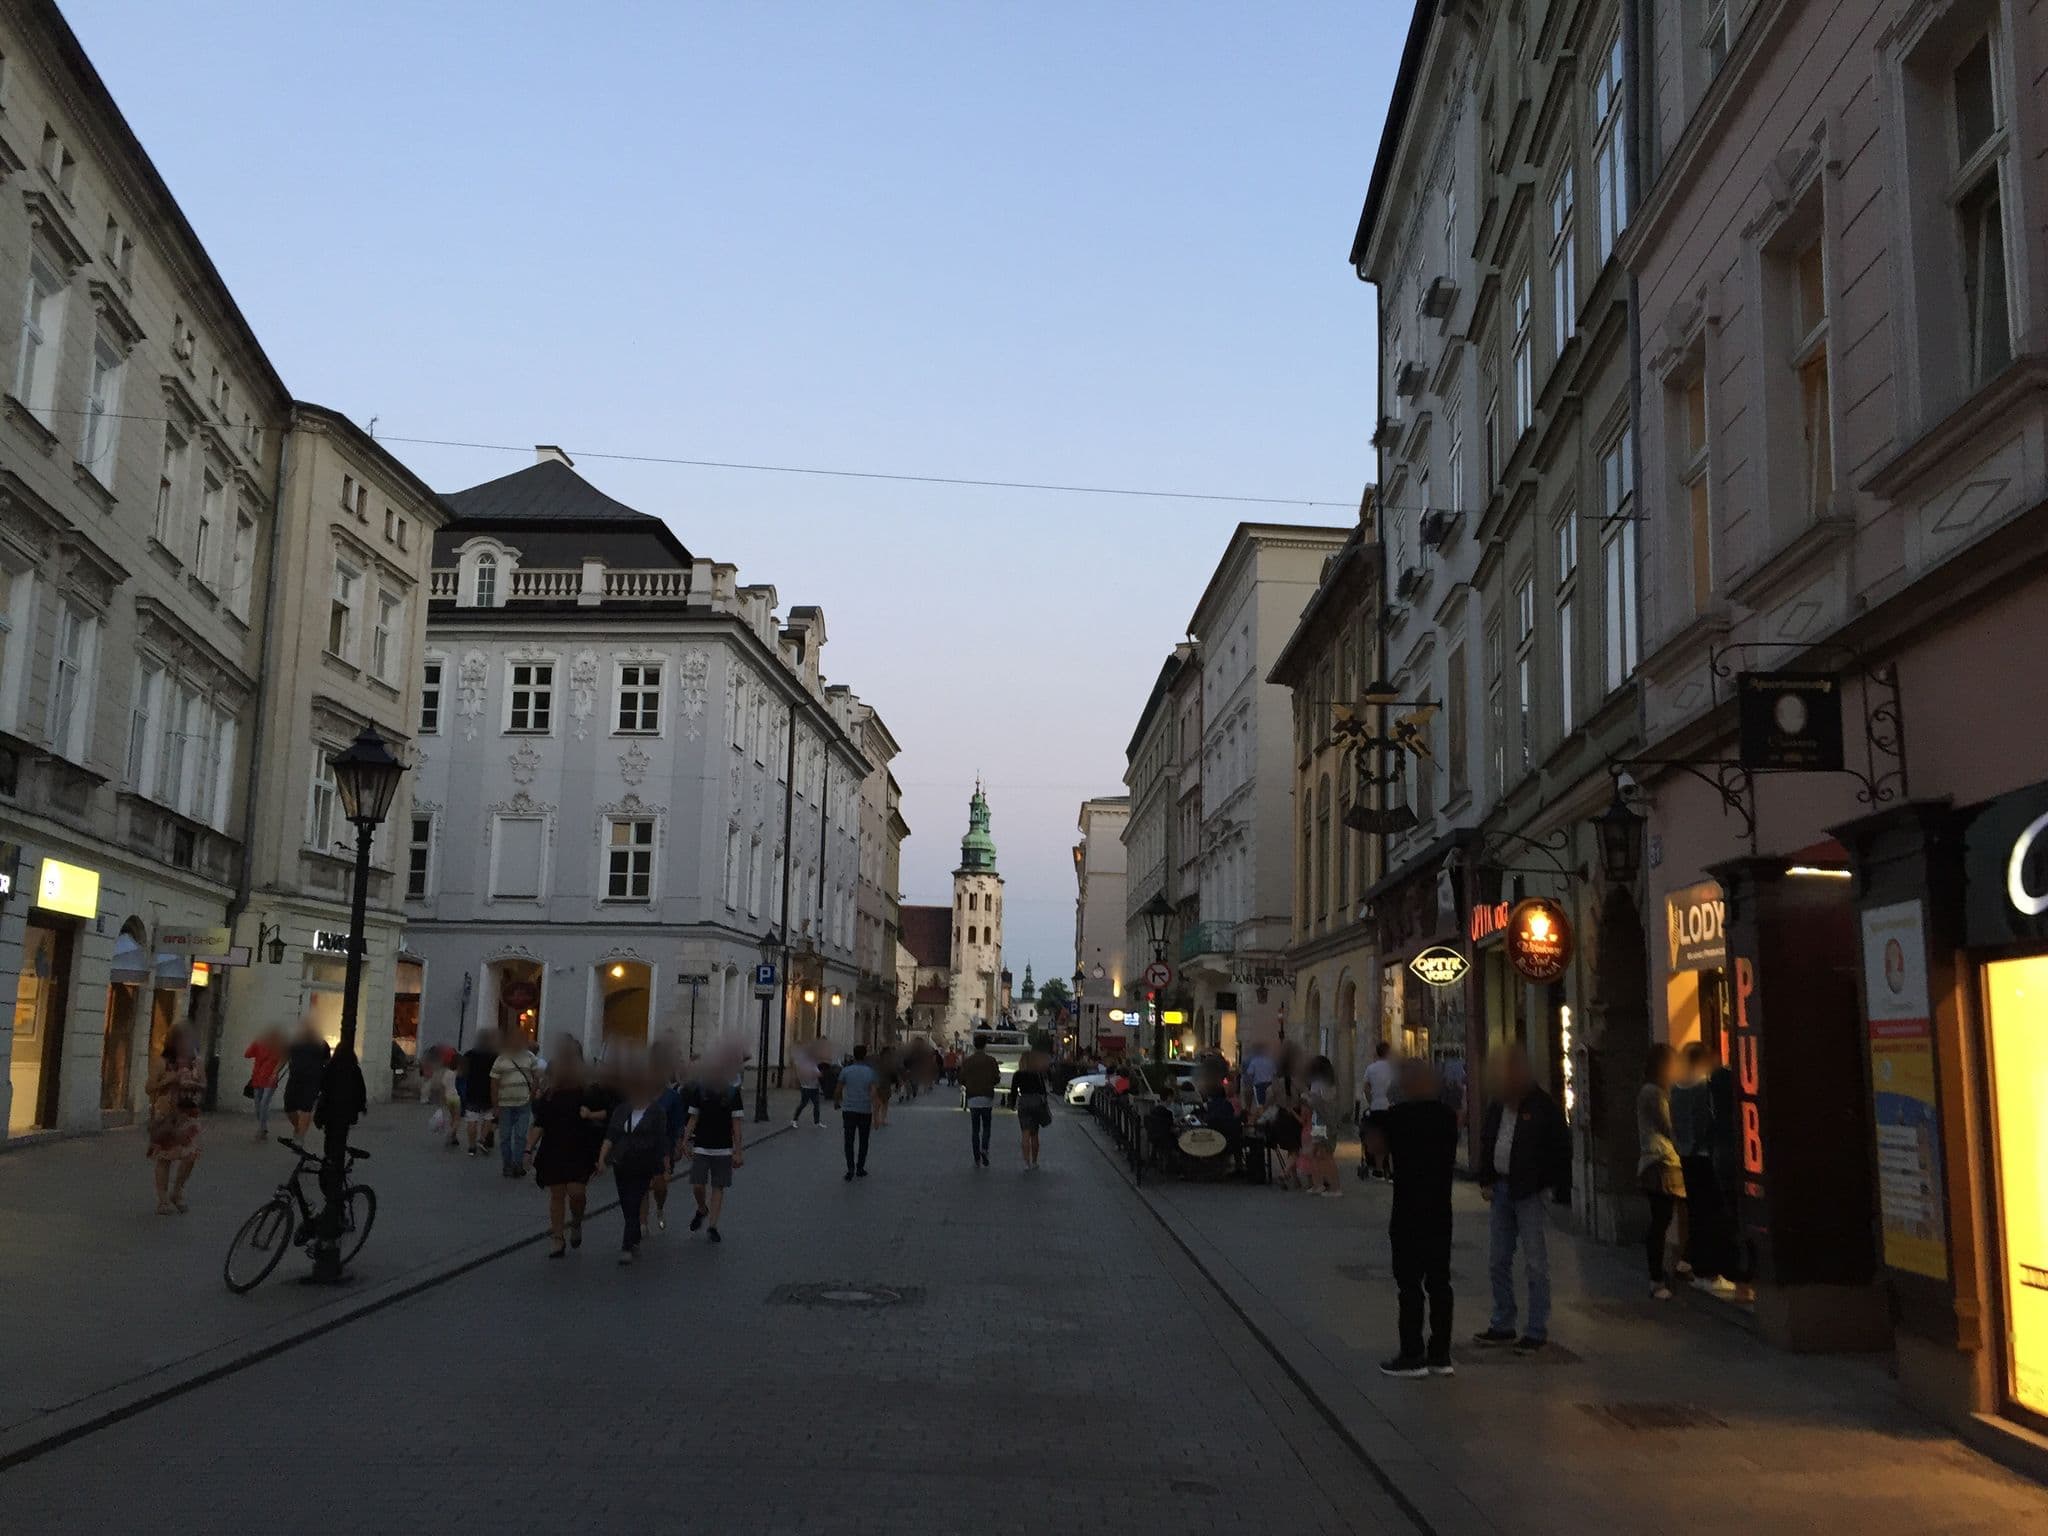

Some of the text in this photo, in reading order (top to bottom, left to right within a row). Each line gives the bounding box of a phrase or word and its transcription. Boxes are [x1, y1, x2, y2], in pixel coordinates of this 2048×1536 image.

[1678, 901, 1725, 946] LODY
[759, 967, 772, 982] P
[1416, 957, 1463, 971] OPTYK
[1735, 957, 1765, 1173] PUB
